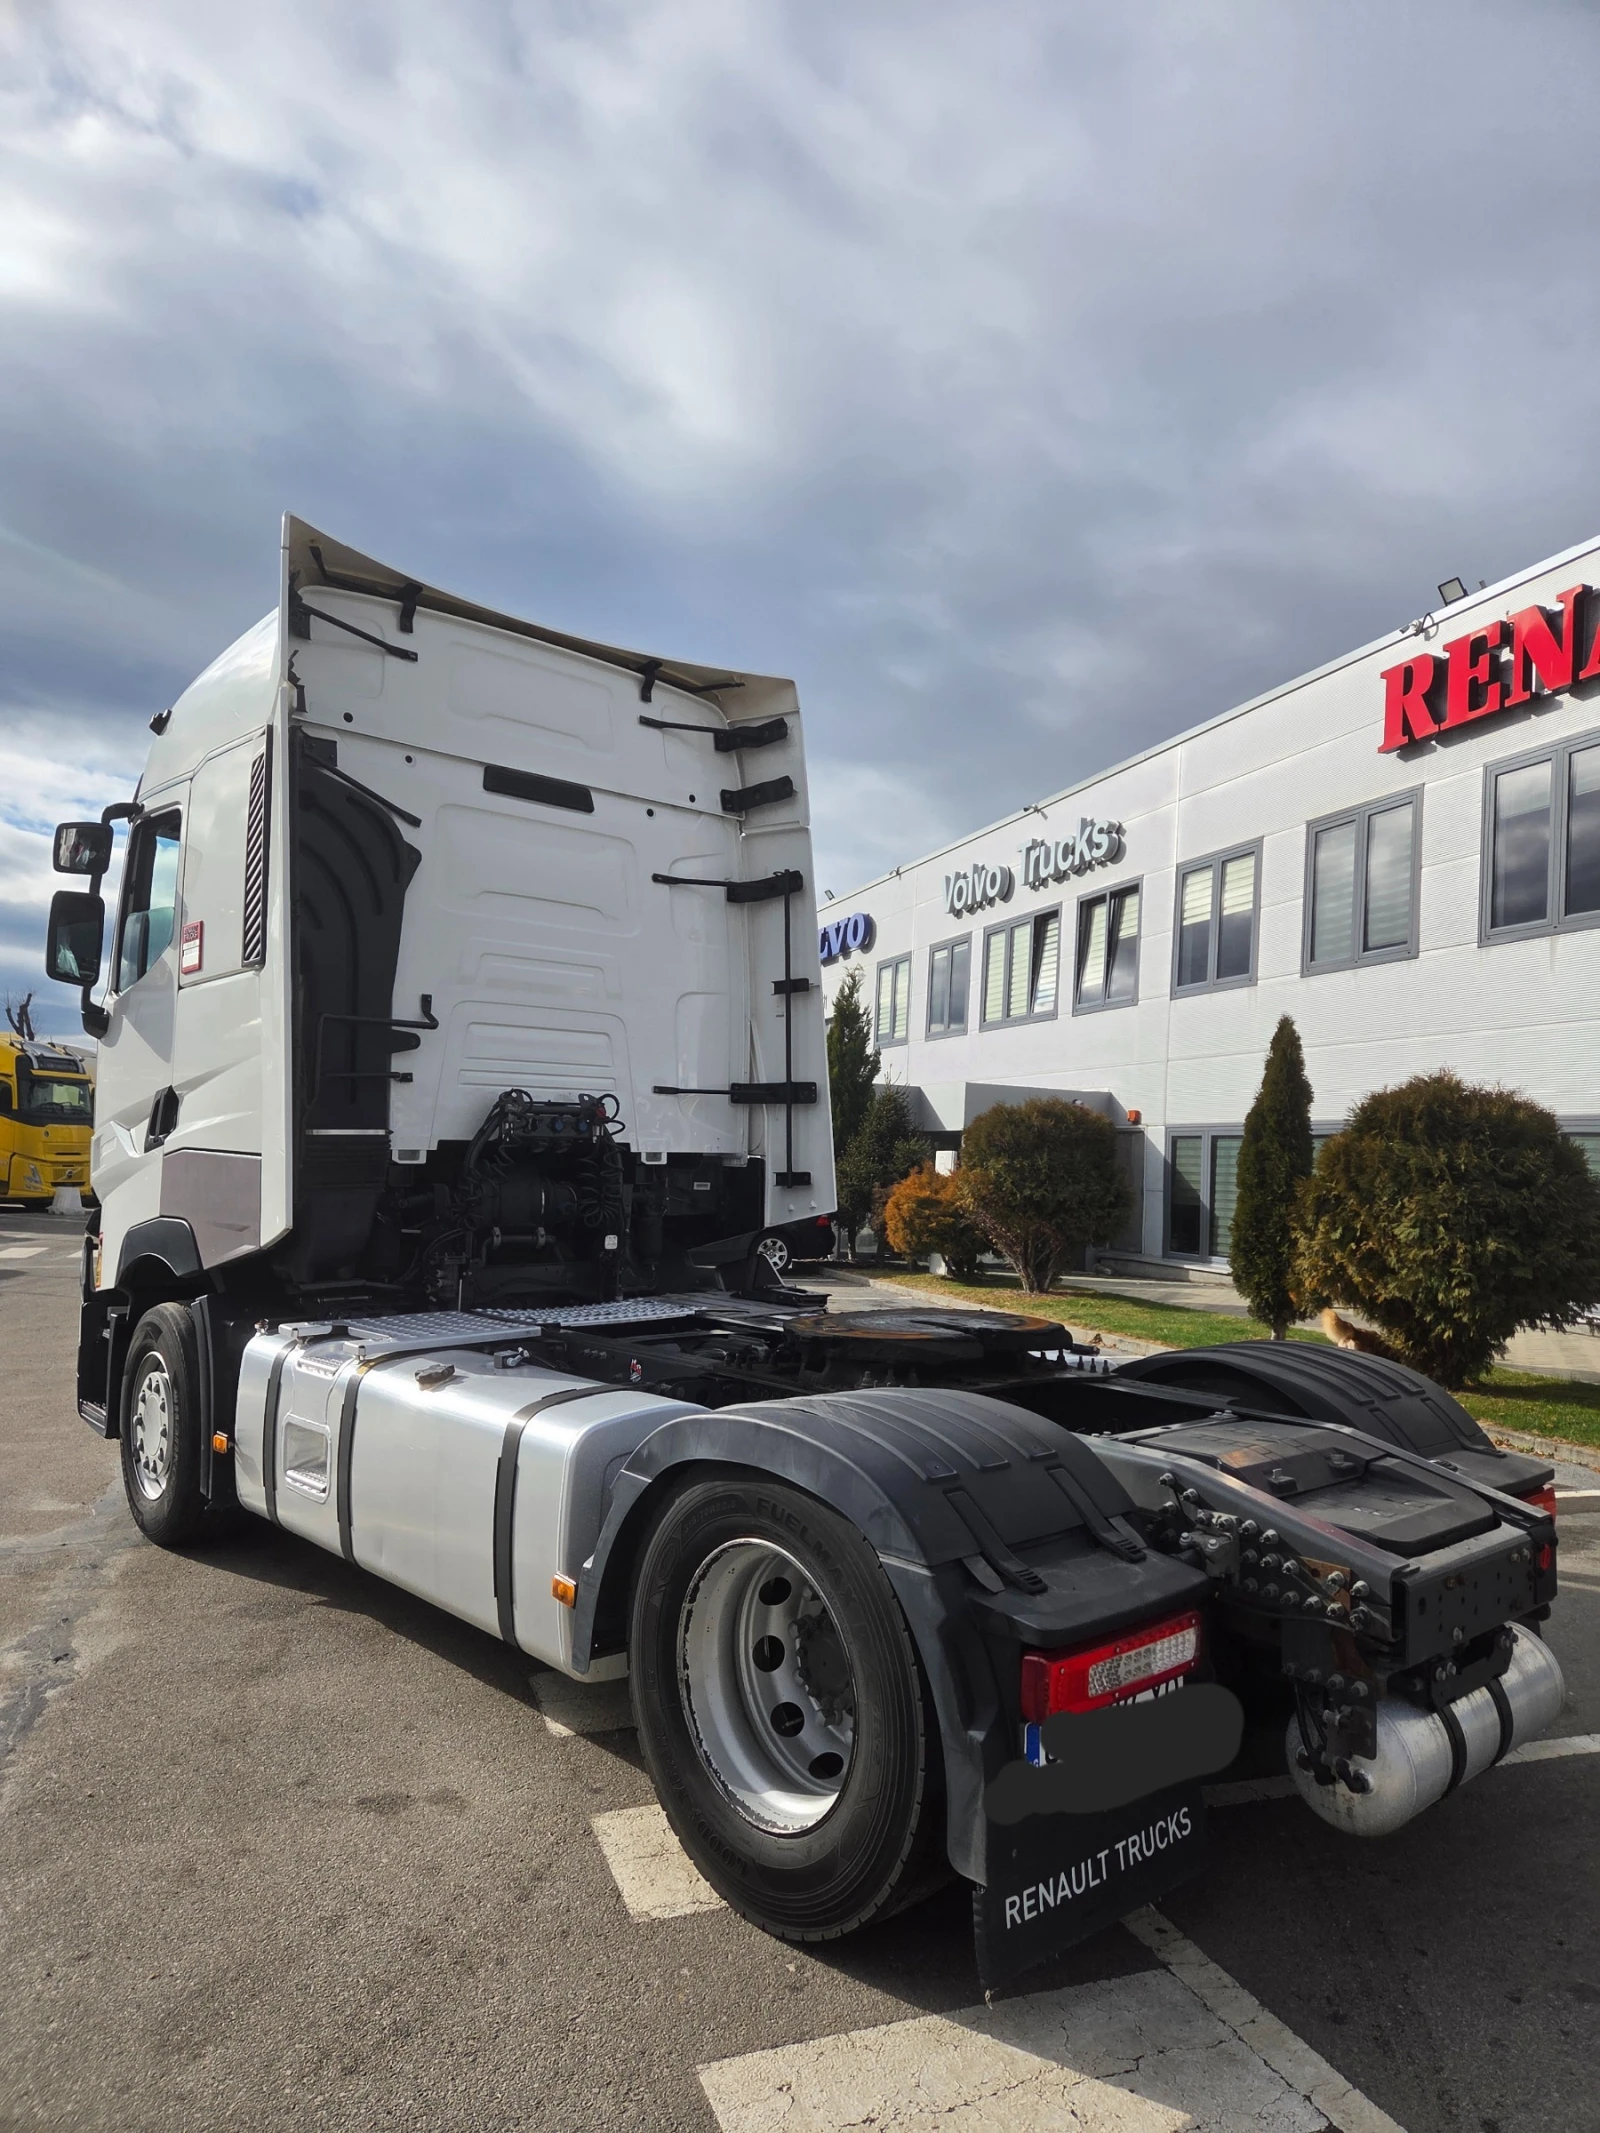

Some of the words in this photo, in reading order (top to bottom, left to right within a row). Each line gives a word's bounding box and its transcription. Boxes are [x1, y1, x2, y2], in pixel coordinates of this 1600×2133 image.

[943, 862, 1006, 916] Volvo
[1017, 816, 1116, 888] Trucks
[756, 1494, 857, 1607] FUELMAX
[1004, 1848, 1109, 1930] RENAULT
[1114, 1806, 1193, 1872] TRUCKS
